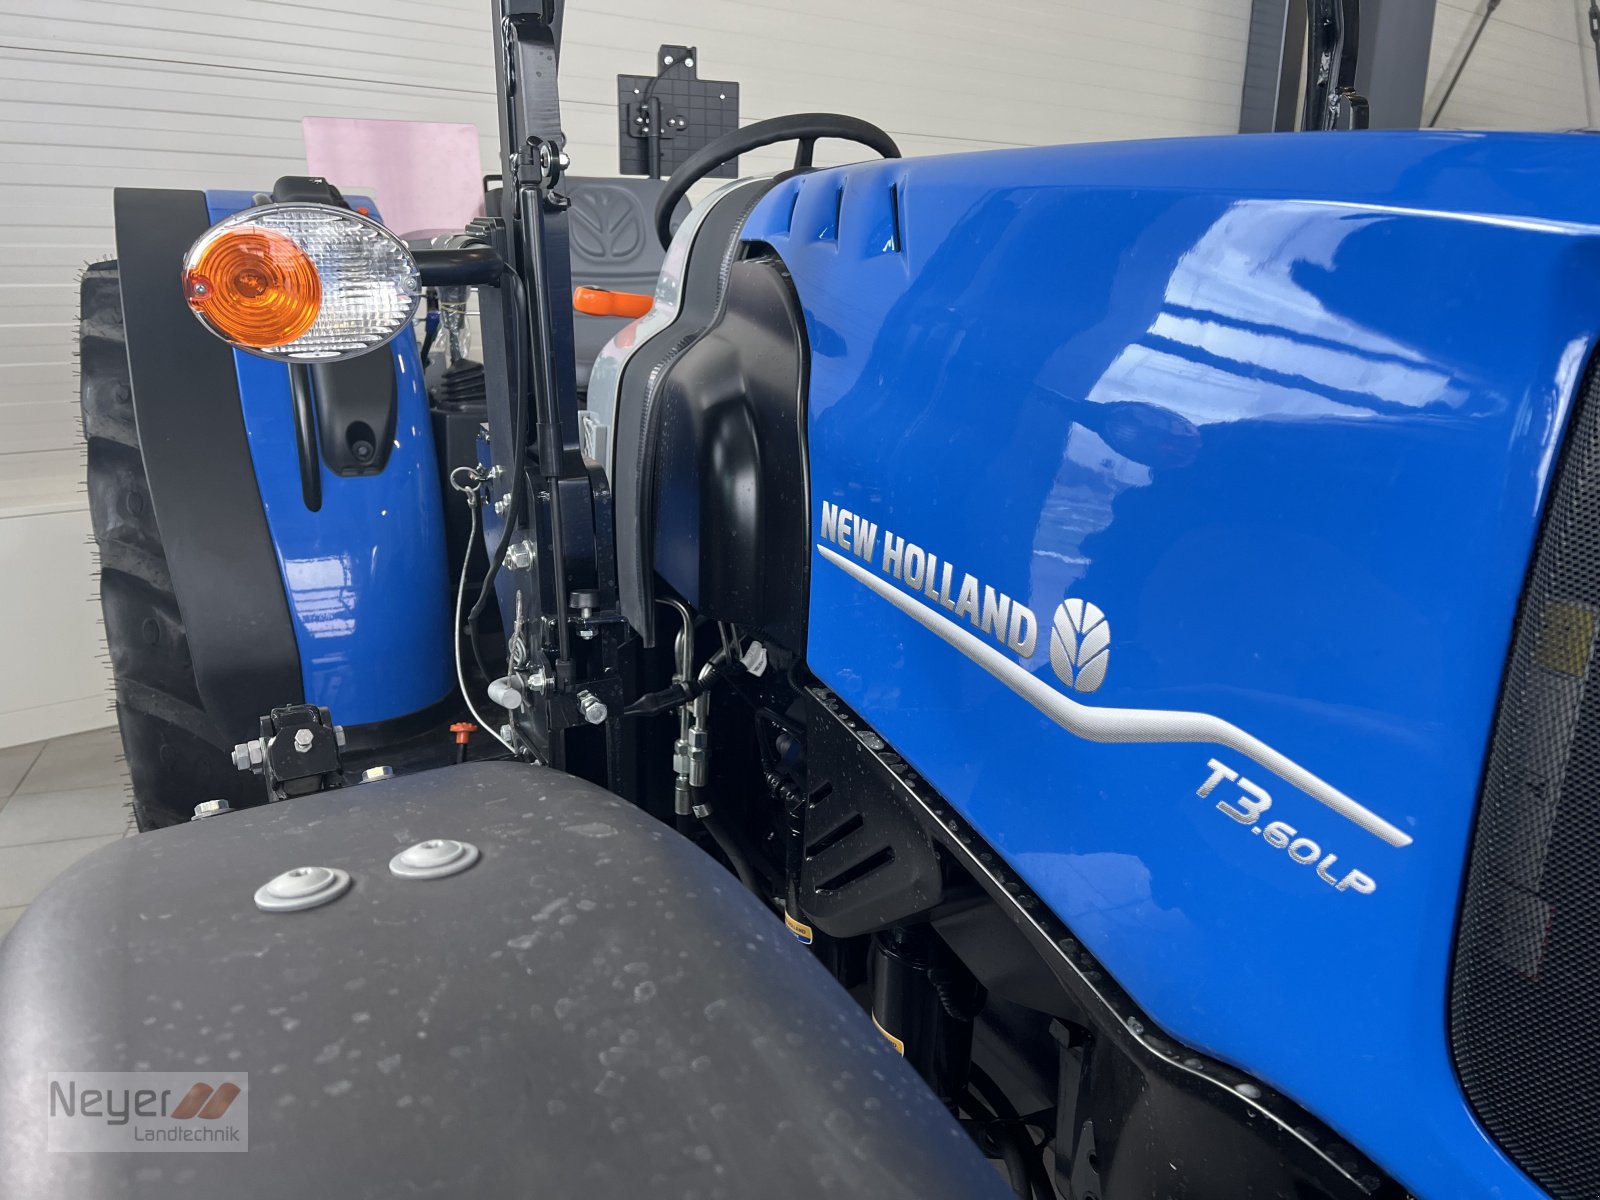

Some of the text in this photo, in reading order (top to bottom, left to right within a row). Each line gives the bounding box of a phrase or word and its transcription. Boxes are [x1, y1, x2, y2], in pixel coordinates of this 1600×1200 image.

[821, 500, 1037, 659] NEW HOLLAND
[1195, 758, 1377, 894] T3.60LP
